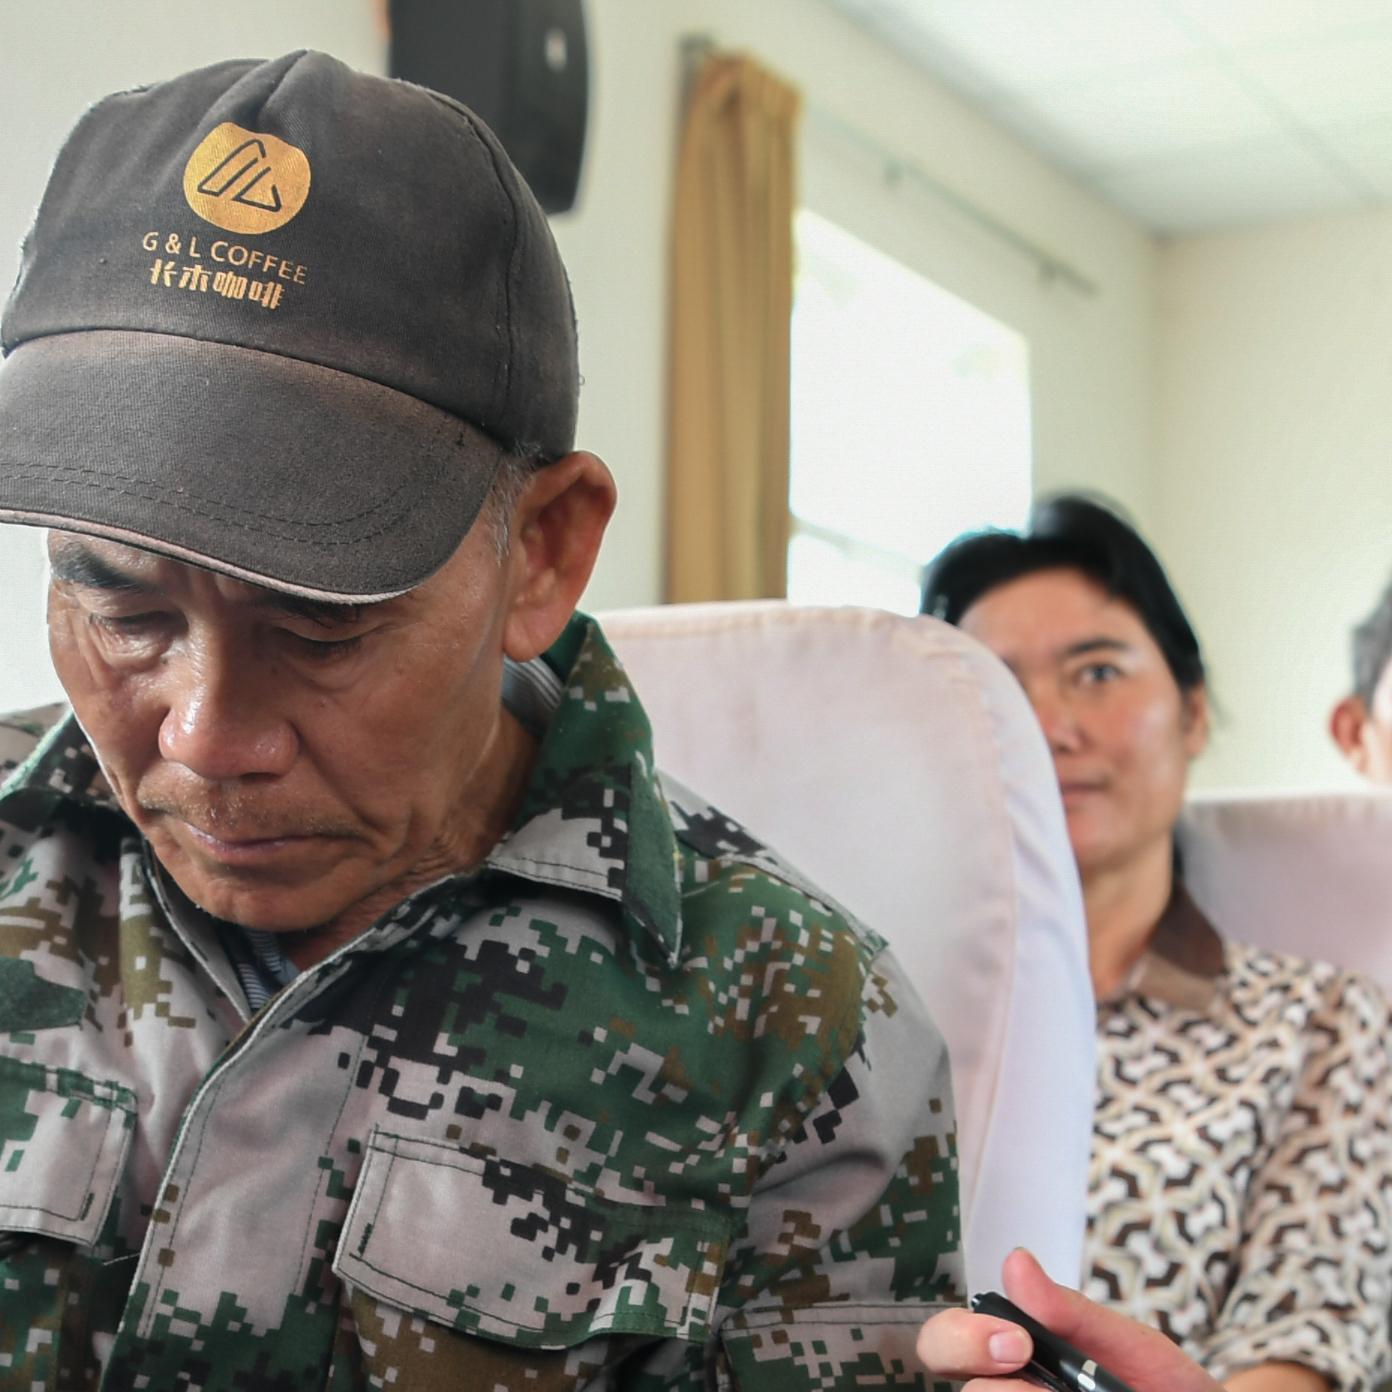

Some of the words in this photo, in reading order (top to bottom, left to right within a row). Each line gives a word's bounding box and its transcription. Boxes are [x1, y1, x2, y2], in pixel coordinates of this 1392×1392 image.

[142, 231, 159, 252] G
[164, 232, 183, 255] &
[189, 236, 202, 258] L
[210, 240, 308, 285] COFFEE
